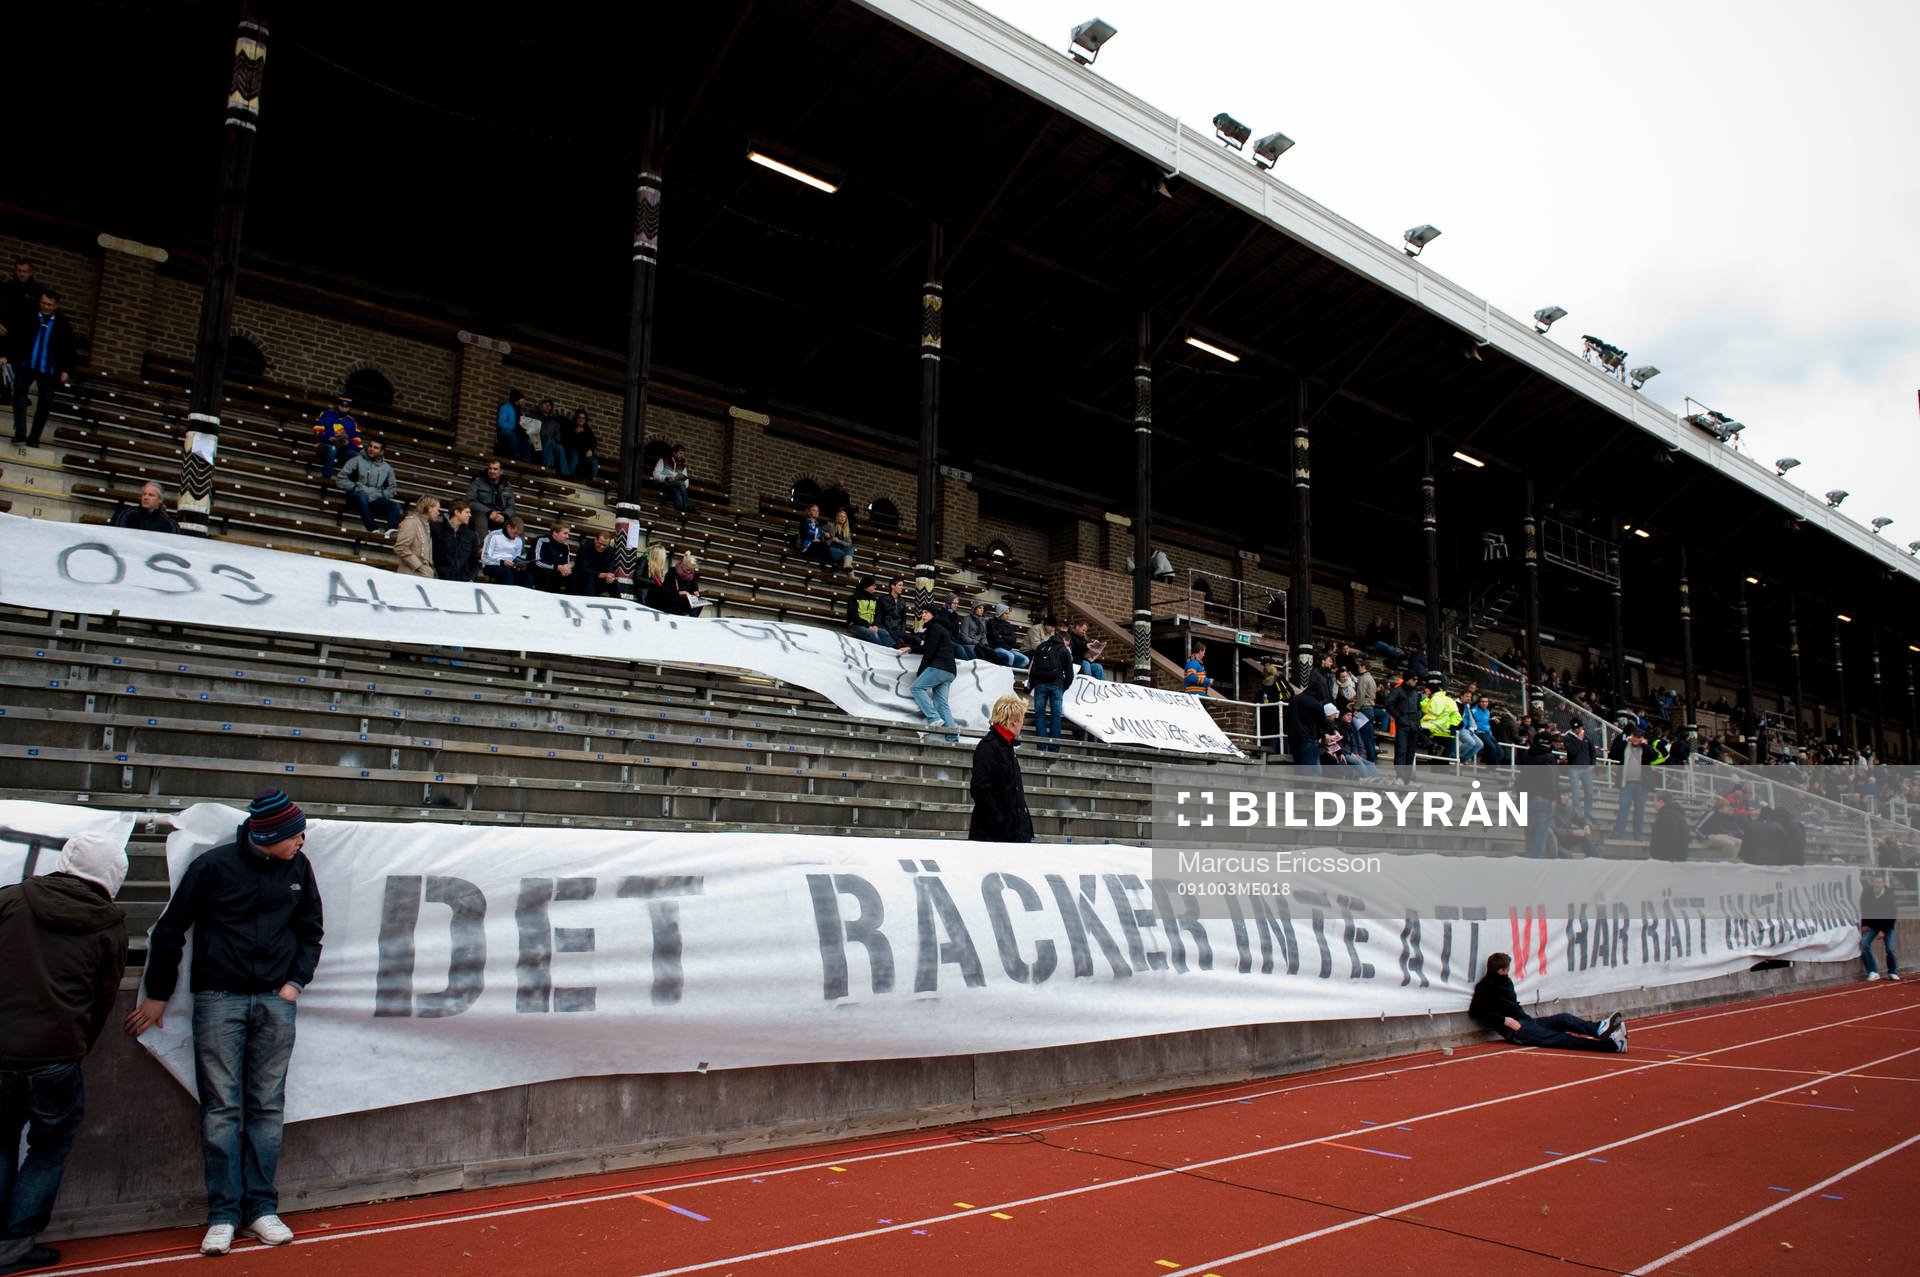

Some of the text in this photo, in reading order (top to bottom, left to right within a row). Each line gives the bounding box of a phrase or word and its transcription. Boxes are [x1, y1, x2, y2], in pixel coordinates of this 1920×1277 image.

[57, 542, 275, 606] OSS
[374, 874, 704, 1018] DET
[806, 859, 1213, 1000] RÄCKER
[1222, 880, 1376, 978] INTE
[1399, 905, 1487, 987] ATT
[1509, 904, 1548, 982] VI
[1641, 887, 1705, 964] RÄTT
